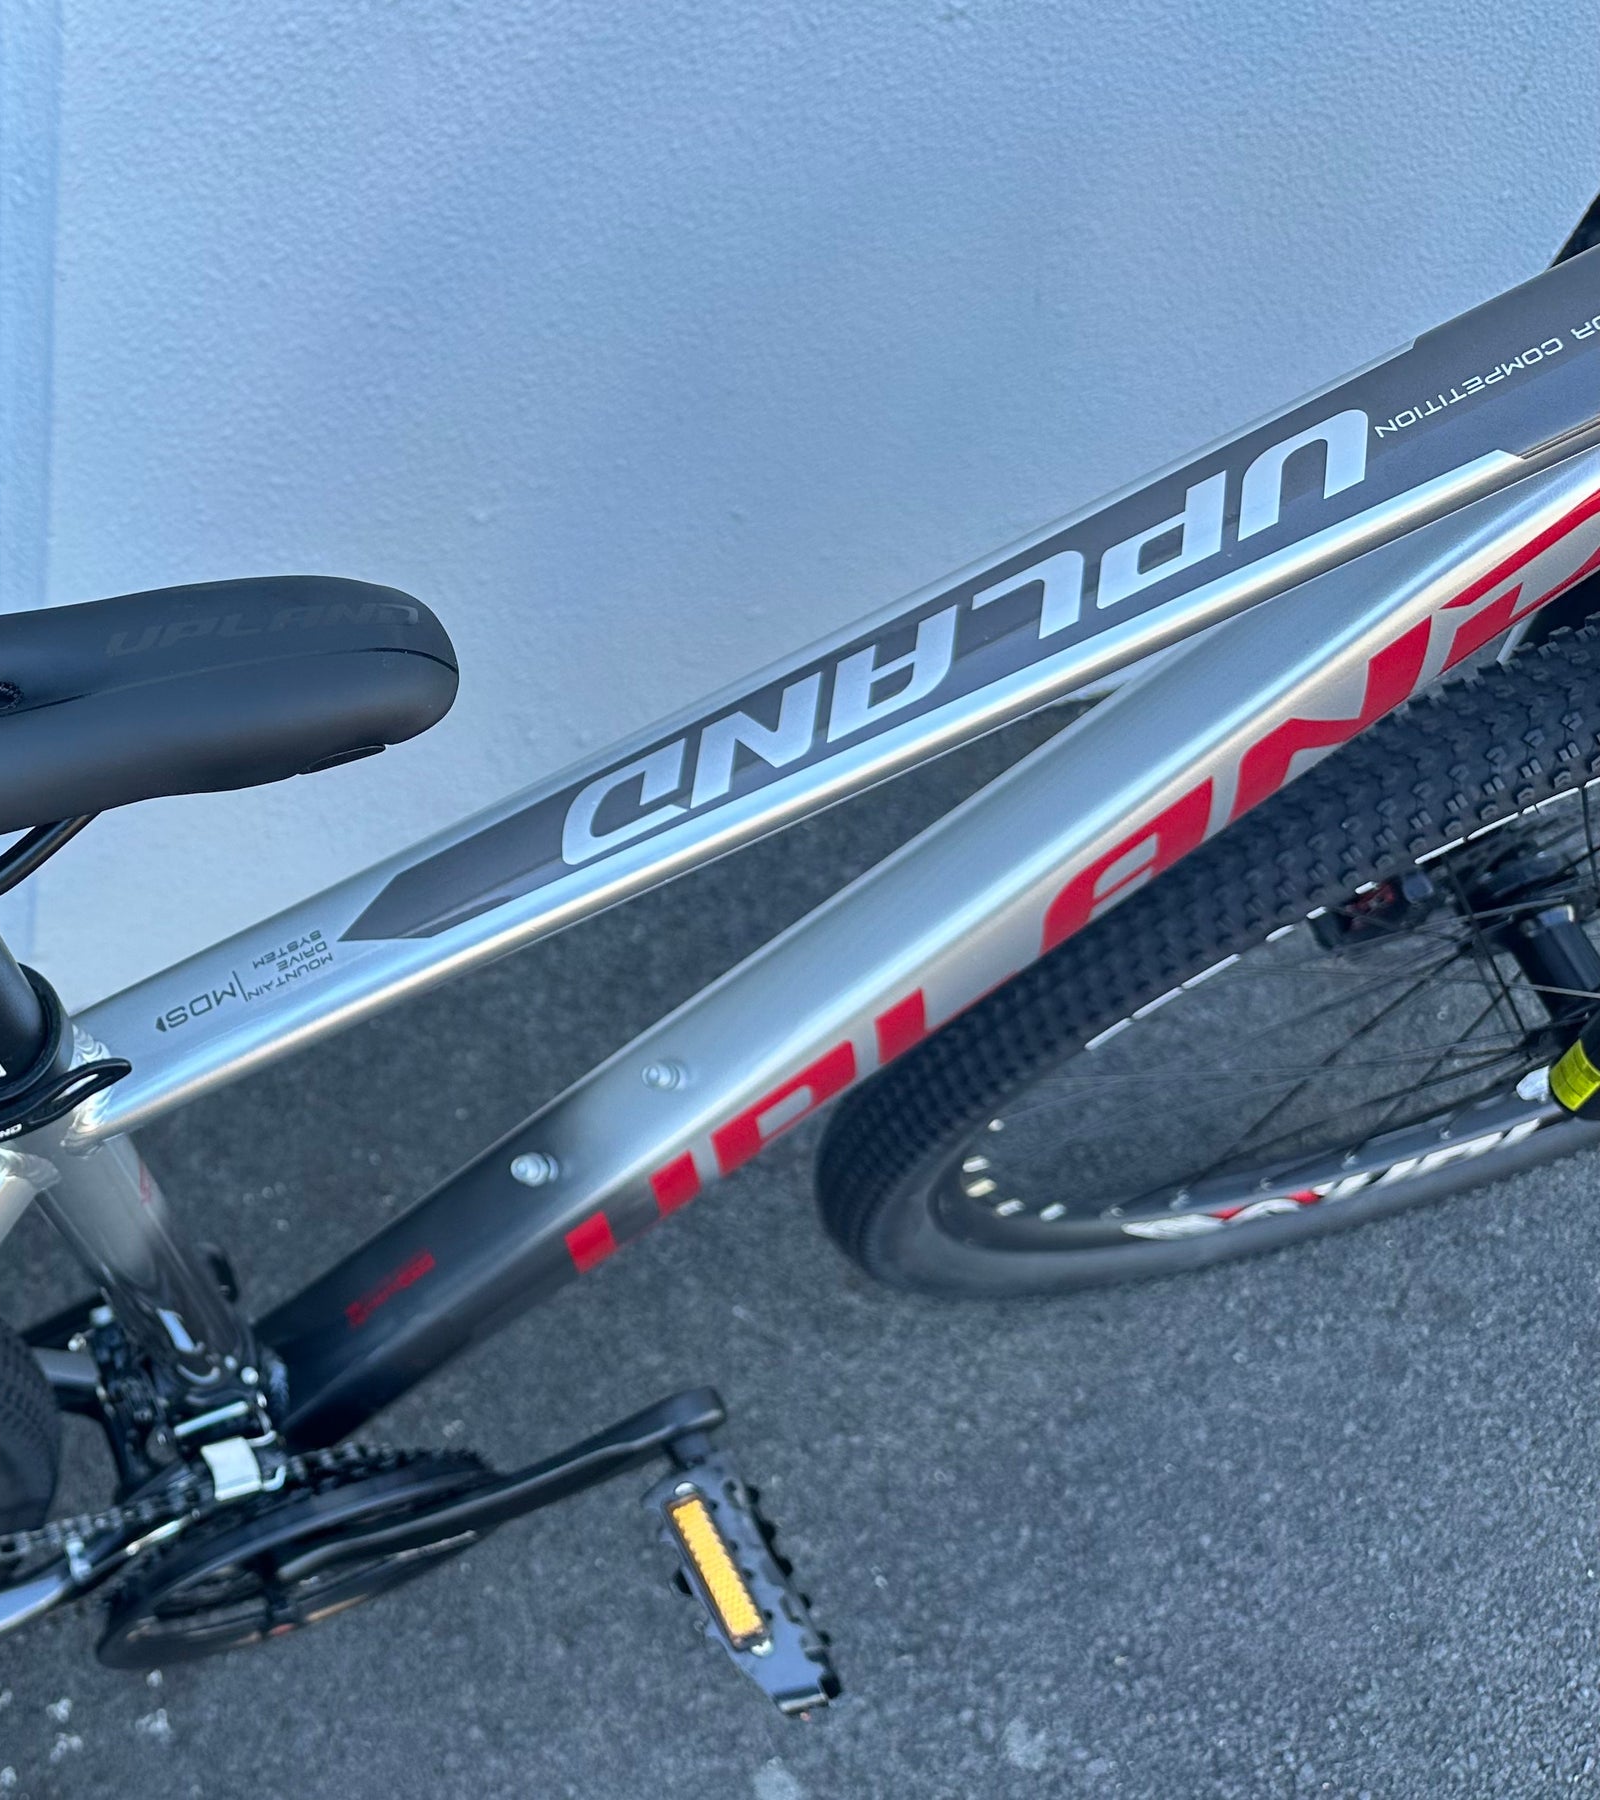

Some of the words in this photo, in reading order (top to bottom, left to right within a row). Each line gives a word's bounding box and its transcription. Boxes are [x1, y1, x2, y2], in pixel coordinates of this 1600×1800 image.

[1374, 337, 1564, 439] COMPETITION
[106, 602, 419, 657] UPLAND
[561, 408, 1369, 867] UPLAND
[252, 930, 322, 970] SYSTEM
[277, 940, 328, 973] DRIVE
[247, 952, 334, 1000] MOUNTAIN
[165, 981, 237, 1029] MDS
